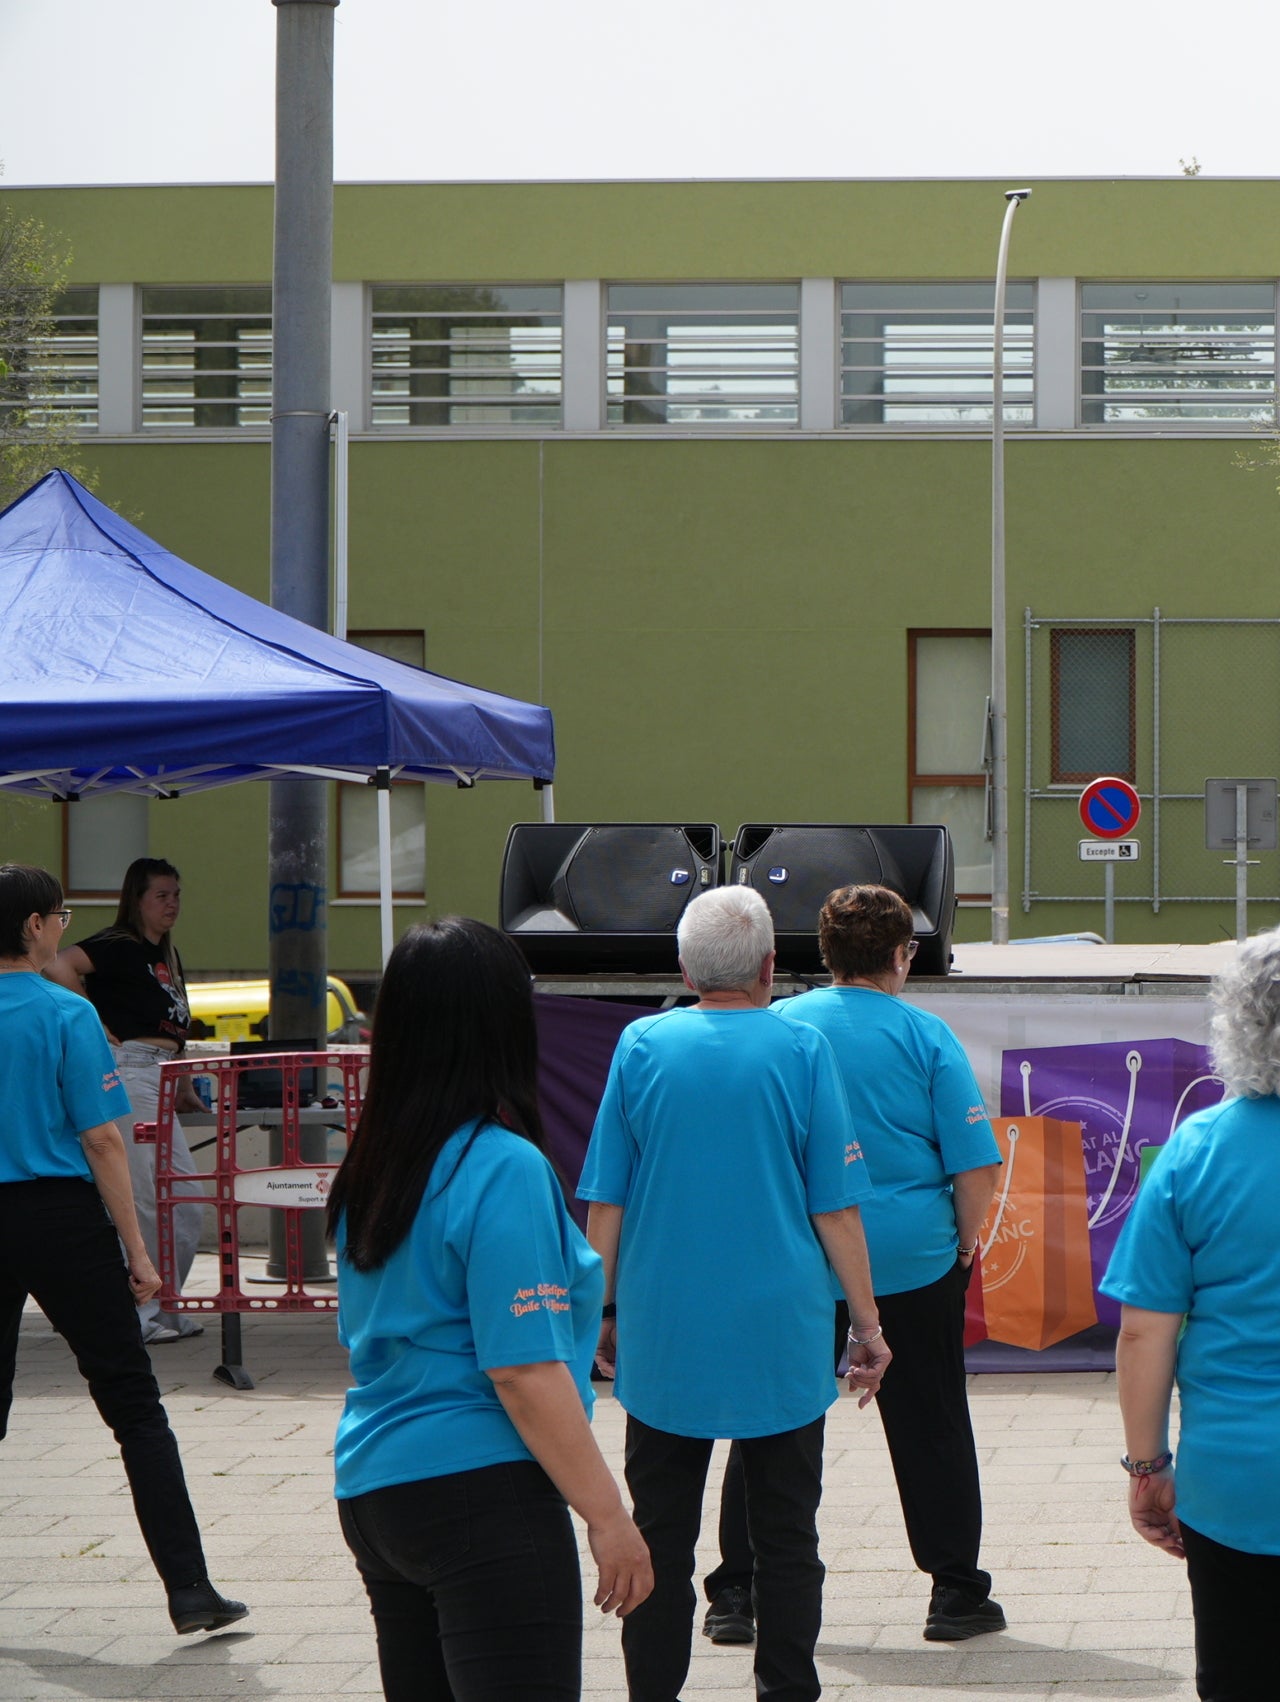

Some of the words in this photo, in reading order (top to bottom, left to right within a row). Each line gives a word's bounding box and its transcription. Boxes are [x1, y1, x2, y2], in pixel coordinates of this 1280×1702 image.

[1086, 848, 1115, 857] Excepte
[1103, 1131, 1121, 1147] AL
[1083, 1138, 1150, 1176] LANC
[266, 1182, 313, 1191] Ajuntament
[513, 1288, 535, 1300] Ana
[510, 1300, 540, 1317] Baile
